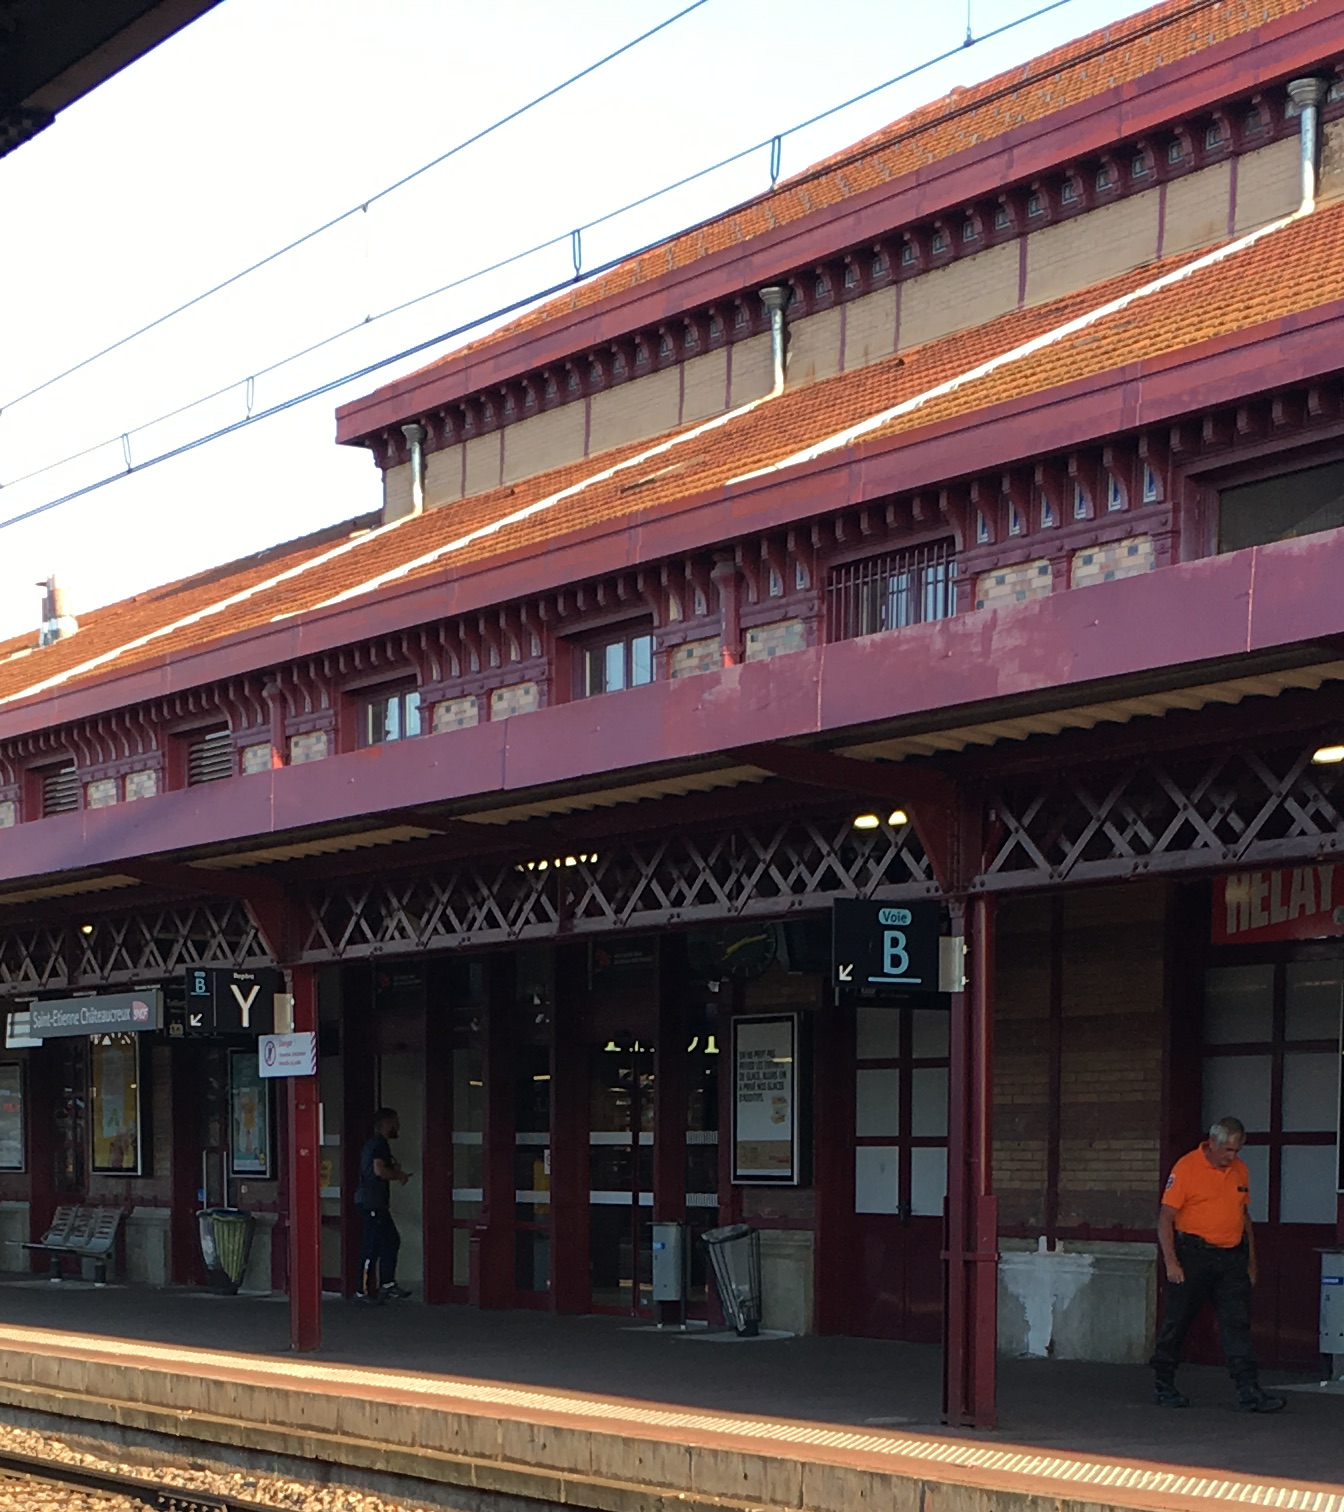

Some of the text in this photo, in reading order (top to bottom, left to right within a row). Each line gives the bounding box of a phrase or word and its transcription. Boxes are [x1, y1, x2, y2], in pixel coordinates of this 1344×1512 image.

[1225, 863, 1336, 935] RELAY
[882, 910, 908, 923] Voie
[883, 930, 910, 975] B
[195, 978, 207, 993] B
[80, 1006, 131, 1025] Châteaucreux
[229, 984, 262, 1028] Y
